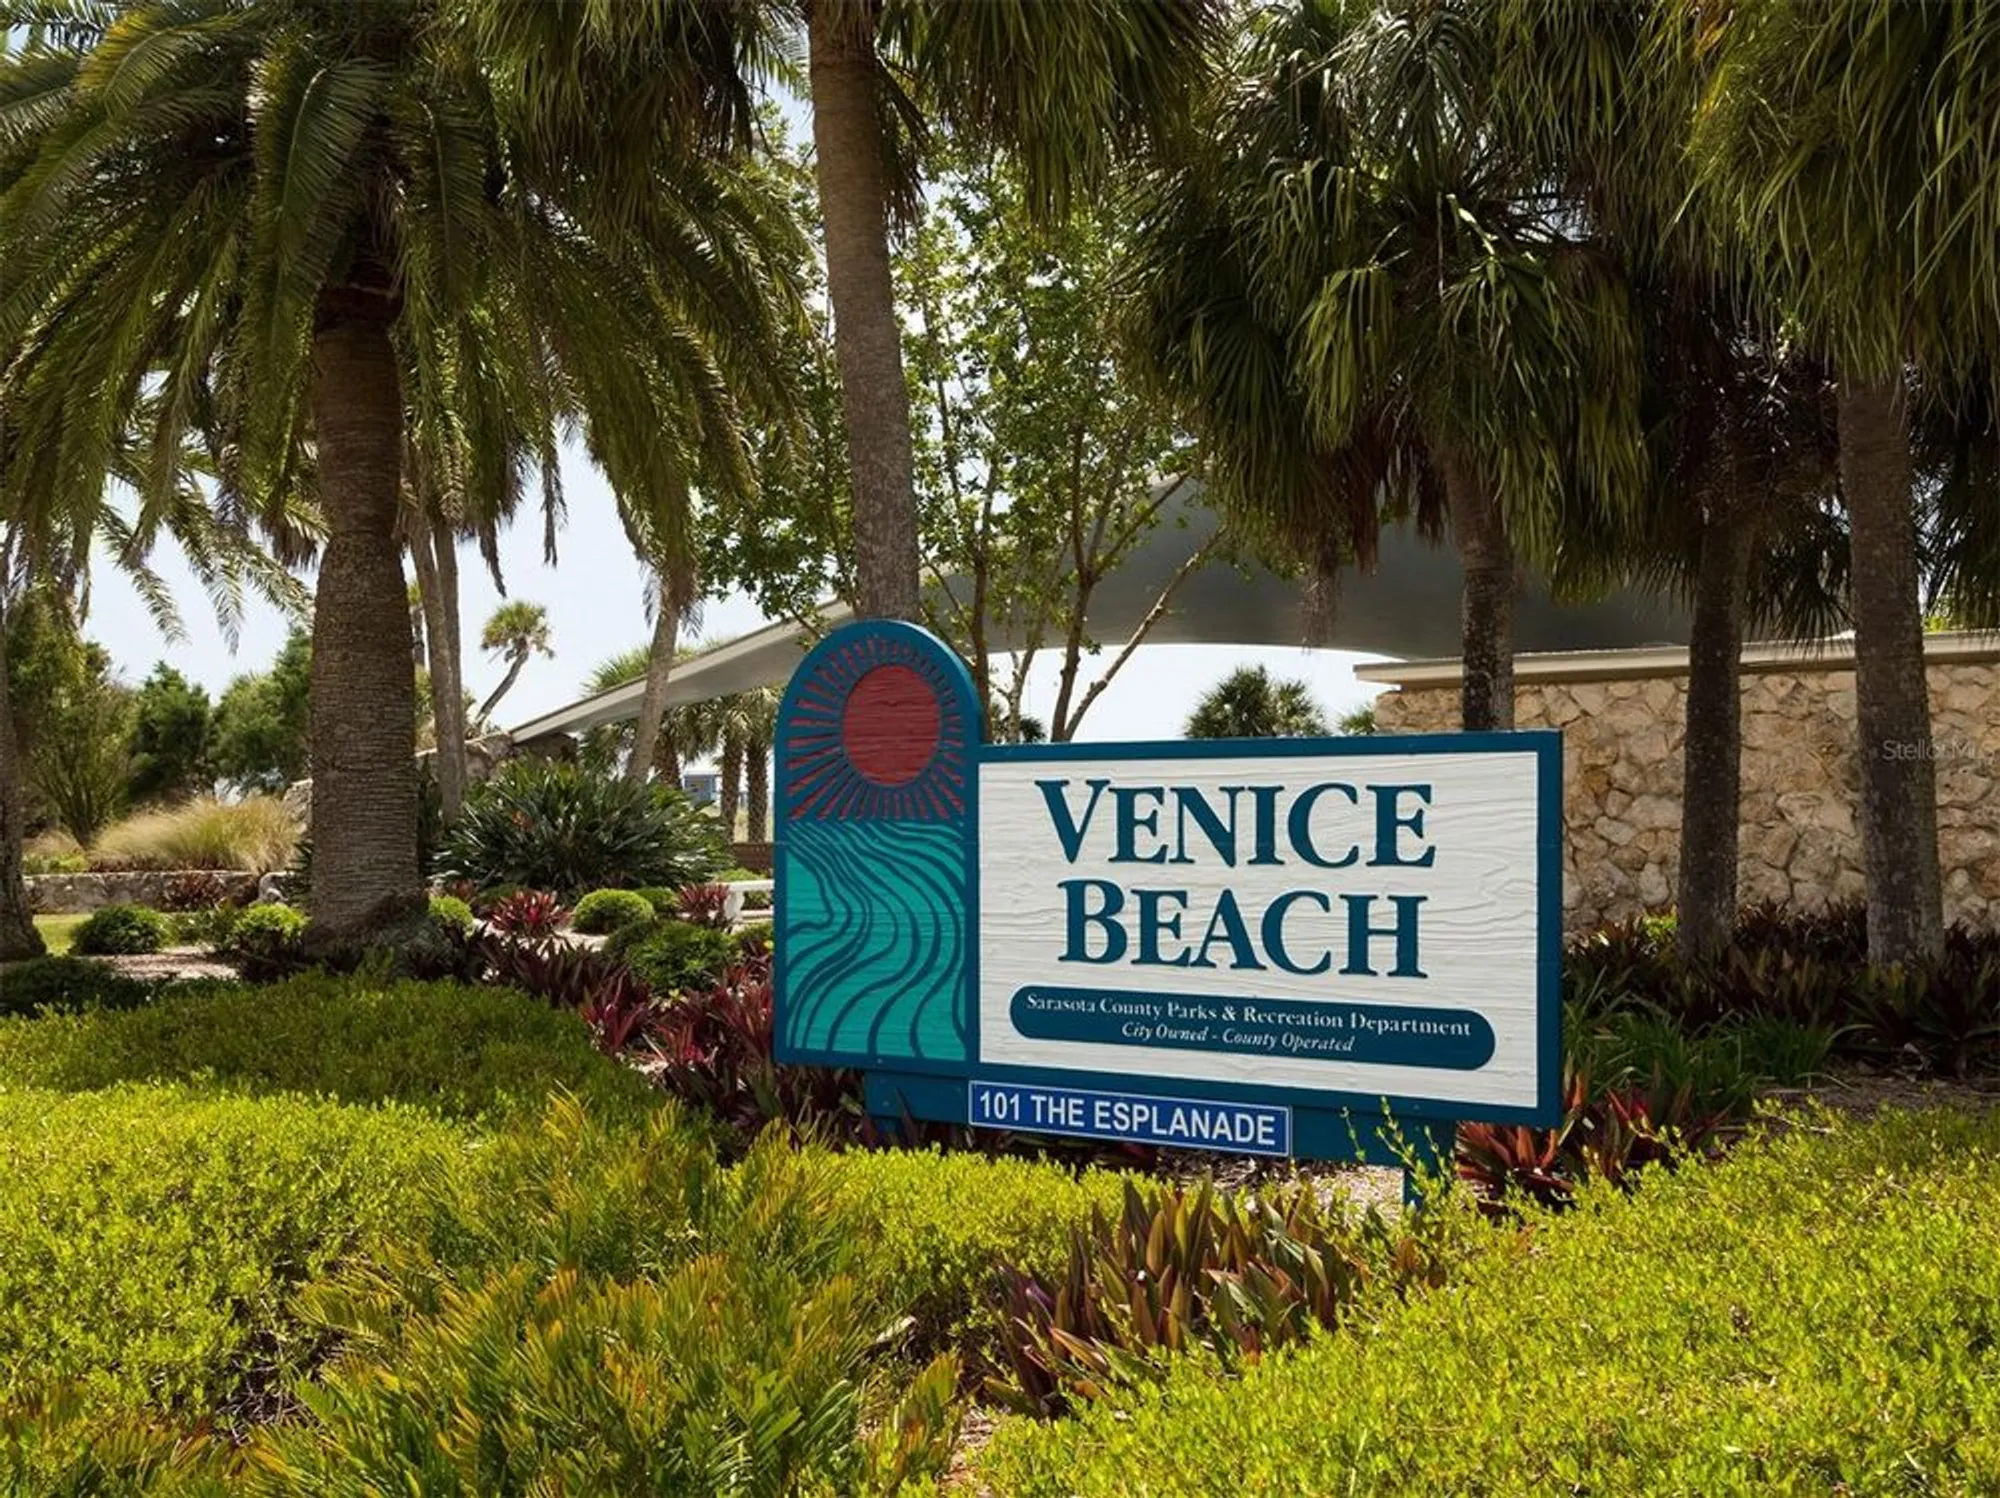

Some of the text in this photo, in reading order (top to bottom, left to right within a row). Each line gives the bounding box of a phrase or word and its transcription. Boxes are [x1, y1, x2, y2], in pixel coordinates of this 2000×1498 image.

[1034, 779, 1437, 868] VENICE
[1057, 879, 1429, 979] BEACH
[1026, 993, 1472, 1036] Sarasota County Parks & Recreation Department
[1121, 1021, 1152, 1041] City
[1155, 1023, 1210, 1042] Owned
[1222, 1027, 1277, 1049] County
[1281, 1031, 1356, 1053] Operated
[979, 1090, 1276, 1145] 101 THE ESPLANADE
